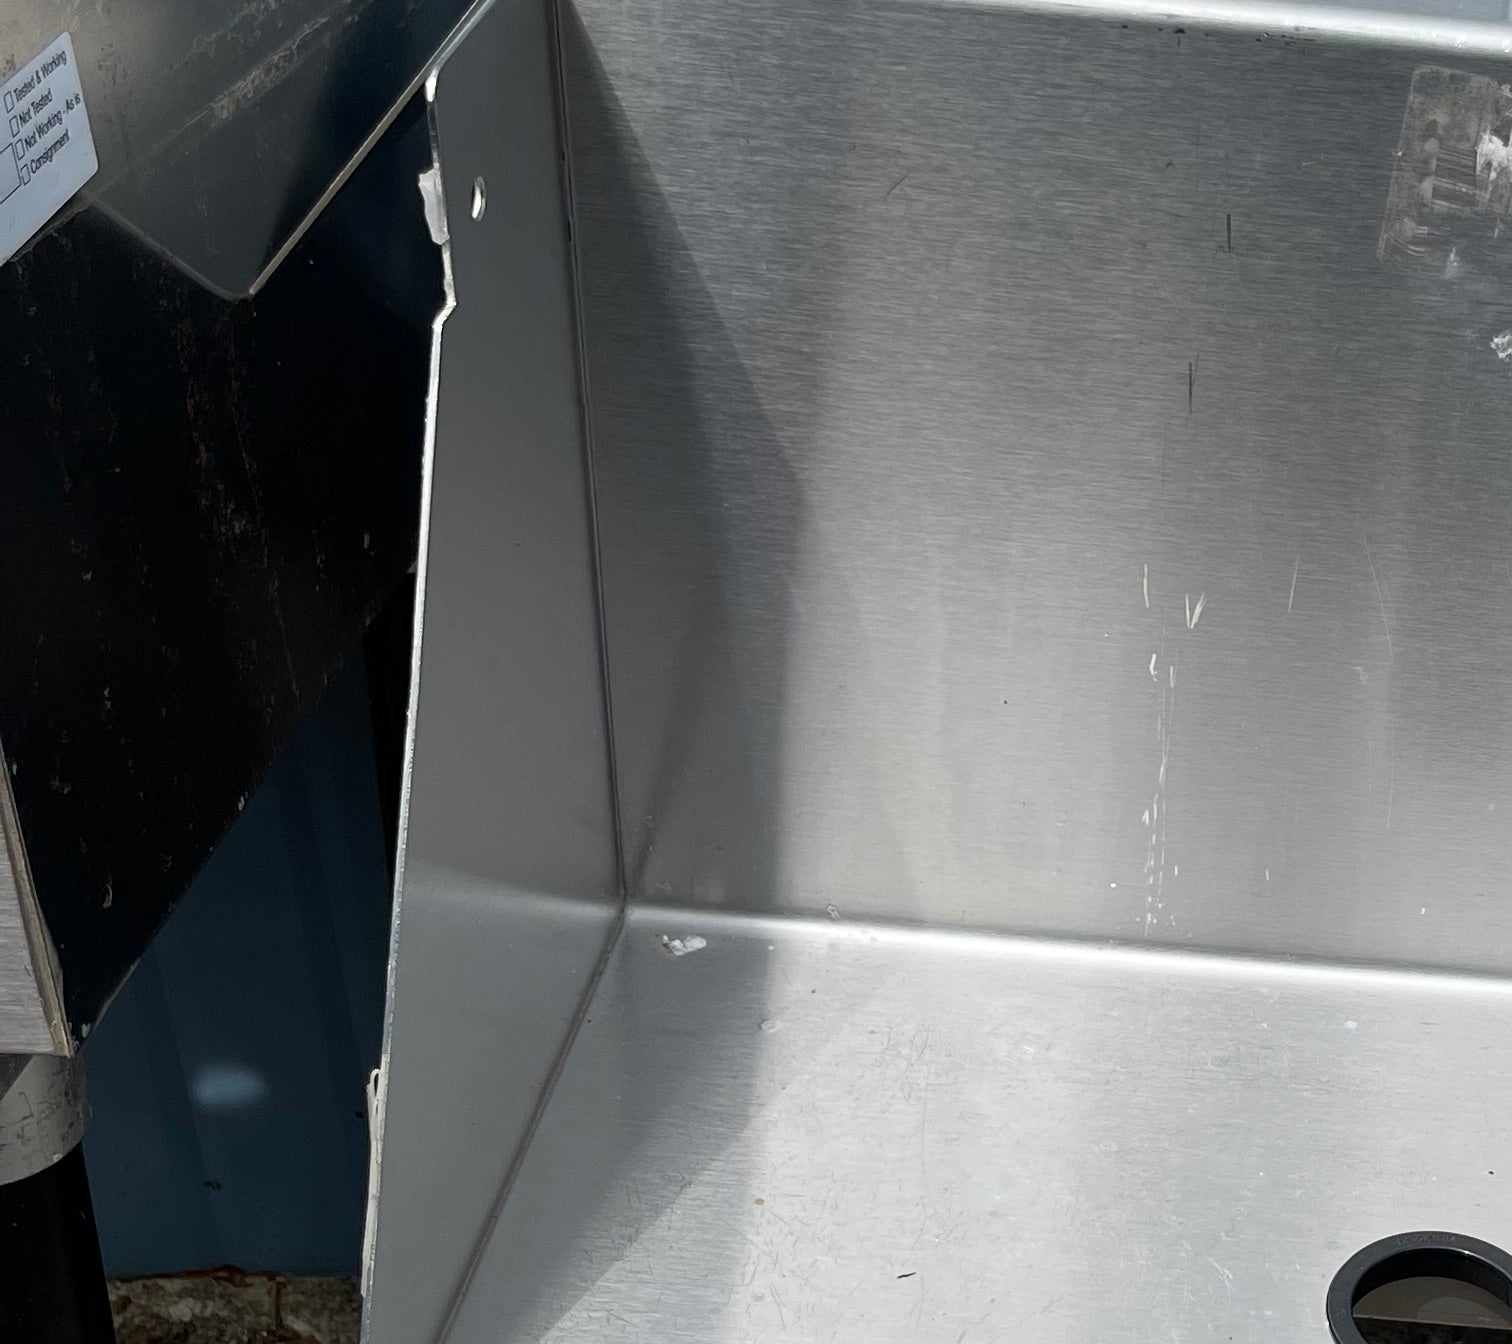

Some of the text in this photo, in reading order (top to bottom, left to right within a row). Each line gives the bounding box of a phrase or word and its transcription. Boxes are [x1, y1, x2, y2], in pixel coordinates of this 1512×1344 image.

[13, 50, 66, 102] Tested & Working
[19, 88, 52, 128] Not Tested
[24, 130, 38, 152] Not
[36, 110, 62, 139] Working
[66, 98, 74, 114] As
[73, 93, 80, 104] is
[30, 128, 70, 174] Consignment
